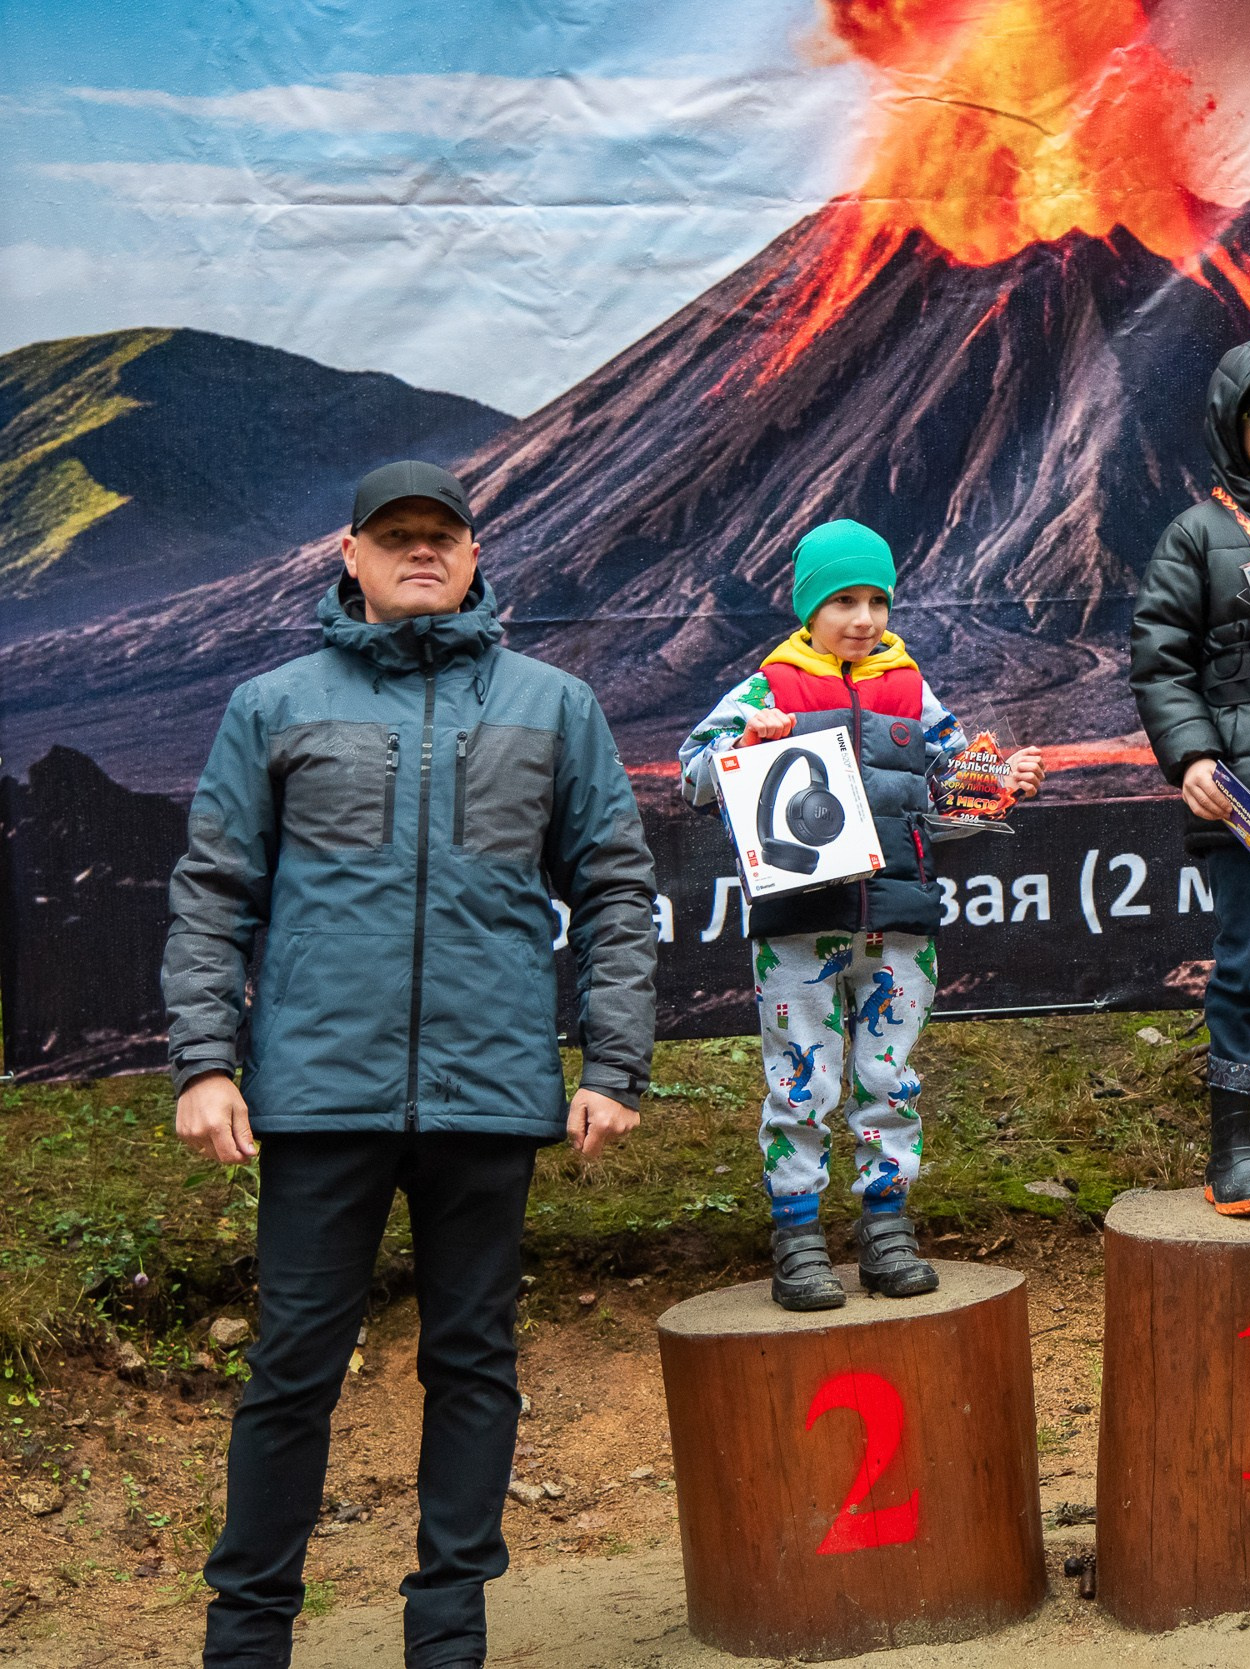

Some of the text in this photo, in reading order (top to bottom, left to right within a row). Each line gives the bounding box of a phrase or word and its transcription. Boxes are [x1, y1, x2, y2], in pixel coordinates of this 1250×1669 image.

[836, 733, 847, 752] TUNE
[964, 751, 997, 763] ТРЕЙЛ
[947, 759, 1011, 775] УРАЛЬСКИЙ
[956, 771, 998, 784] ВУЛКАН
[946, 795, 999, 810] 2 МЕСТО
[960, 813, 980, 823] 2026
[1080, 849, 1151, 934] (2
[806, 1372, 918, 1554] 2
